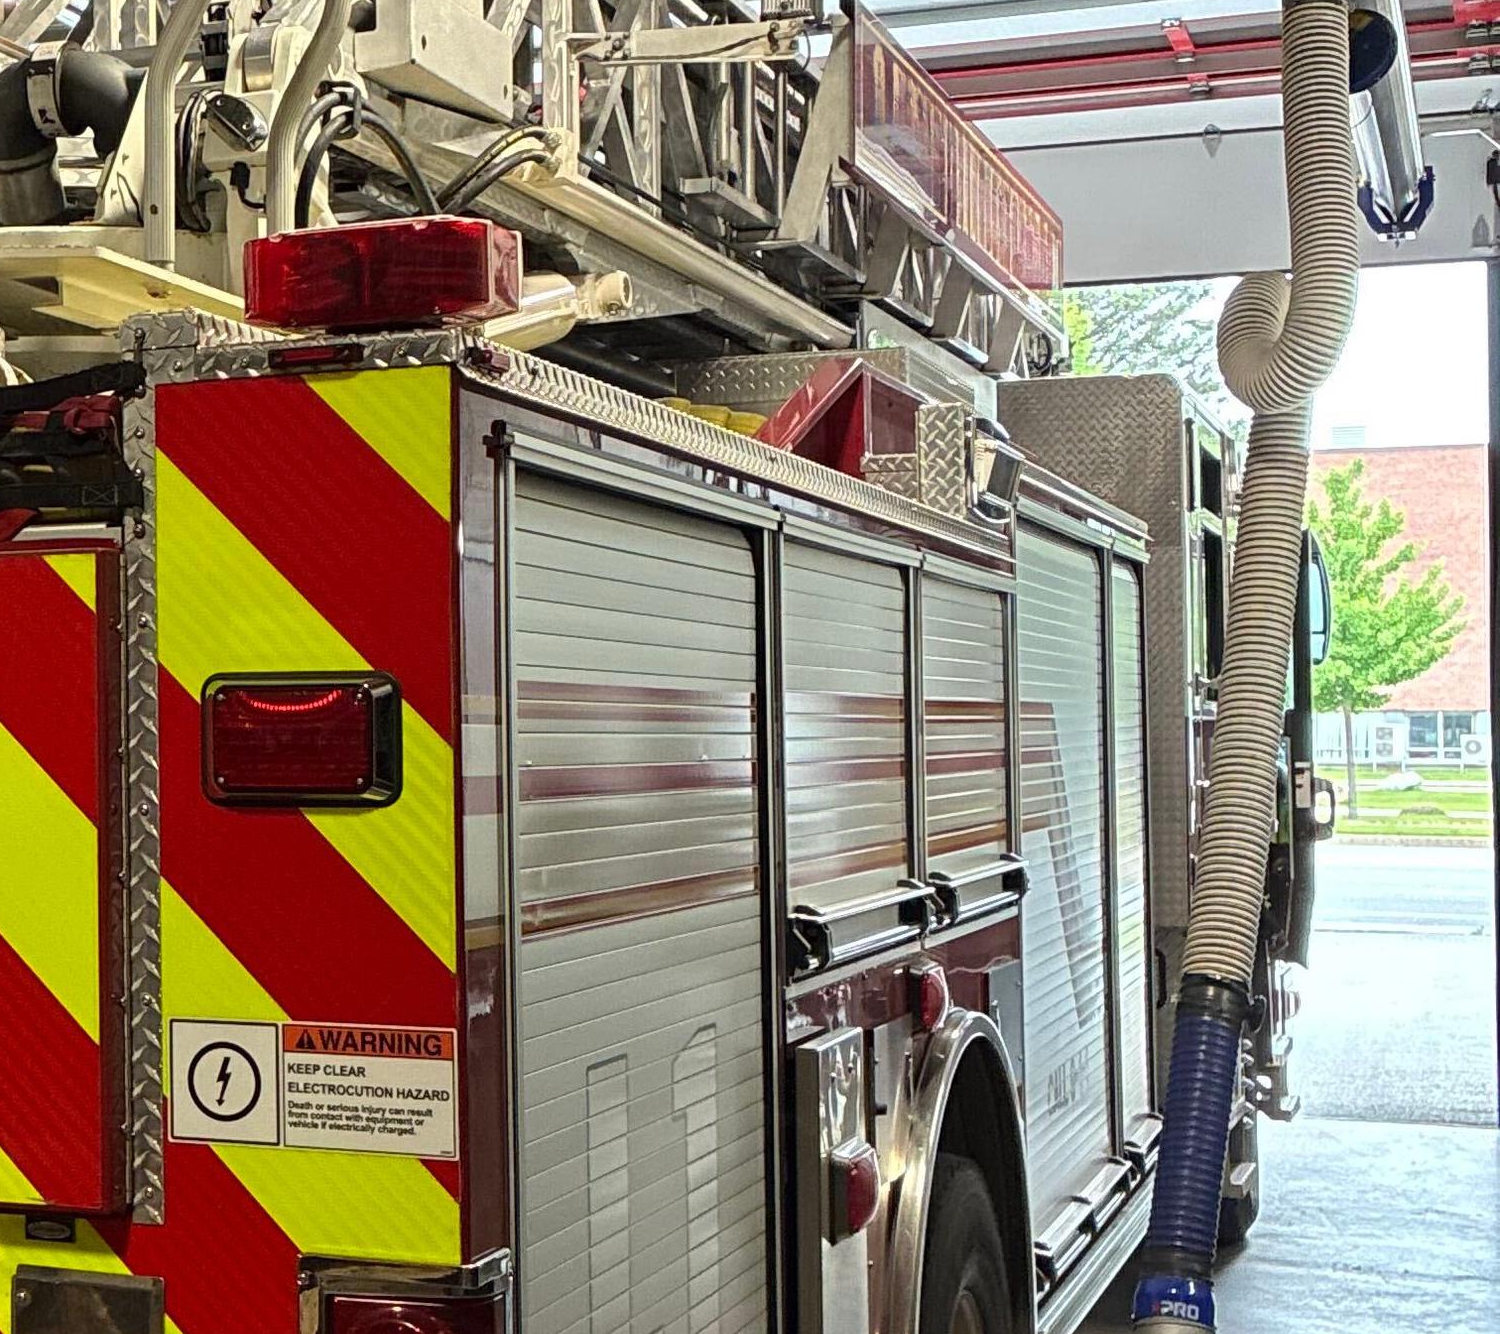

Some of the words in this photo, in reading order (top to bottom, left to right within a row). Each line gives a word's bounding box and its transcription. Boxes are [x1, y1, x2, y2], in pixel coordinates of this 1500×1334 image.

[319, 1030, 442, 1056] WARNING
[287, 1063, 321, 1075] KEEP
[323, 1064, 366, 1078] CLEAR
[287, 1082, 393, 1099] ELECTROCUTION
[397, 1088, 450, 1102] HAZARD
[288, 1101, 314, 1110] Death
[327, 1103, 359, 1113] serious
[361, 1105, 386, 1117] injury
[388, 1107, 405, 1116] can
[407, 1108, 433, 1117] result
[288, 1110, 308, 1119] from
[310, 1112, 343, 1121] contact
[345, 1114, 364, 1122] with
[365, 1116, 413, 1126] equipment
[414, 1118, 425, 1126] or
[288, 1120, 319, 1129] vehicle
[321, 1121, 327, 1129] if
[328, 1122, 375, 1135] electrically
[377, 1124, 417, 1136] charged.
